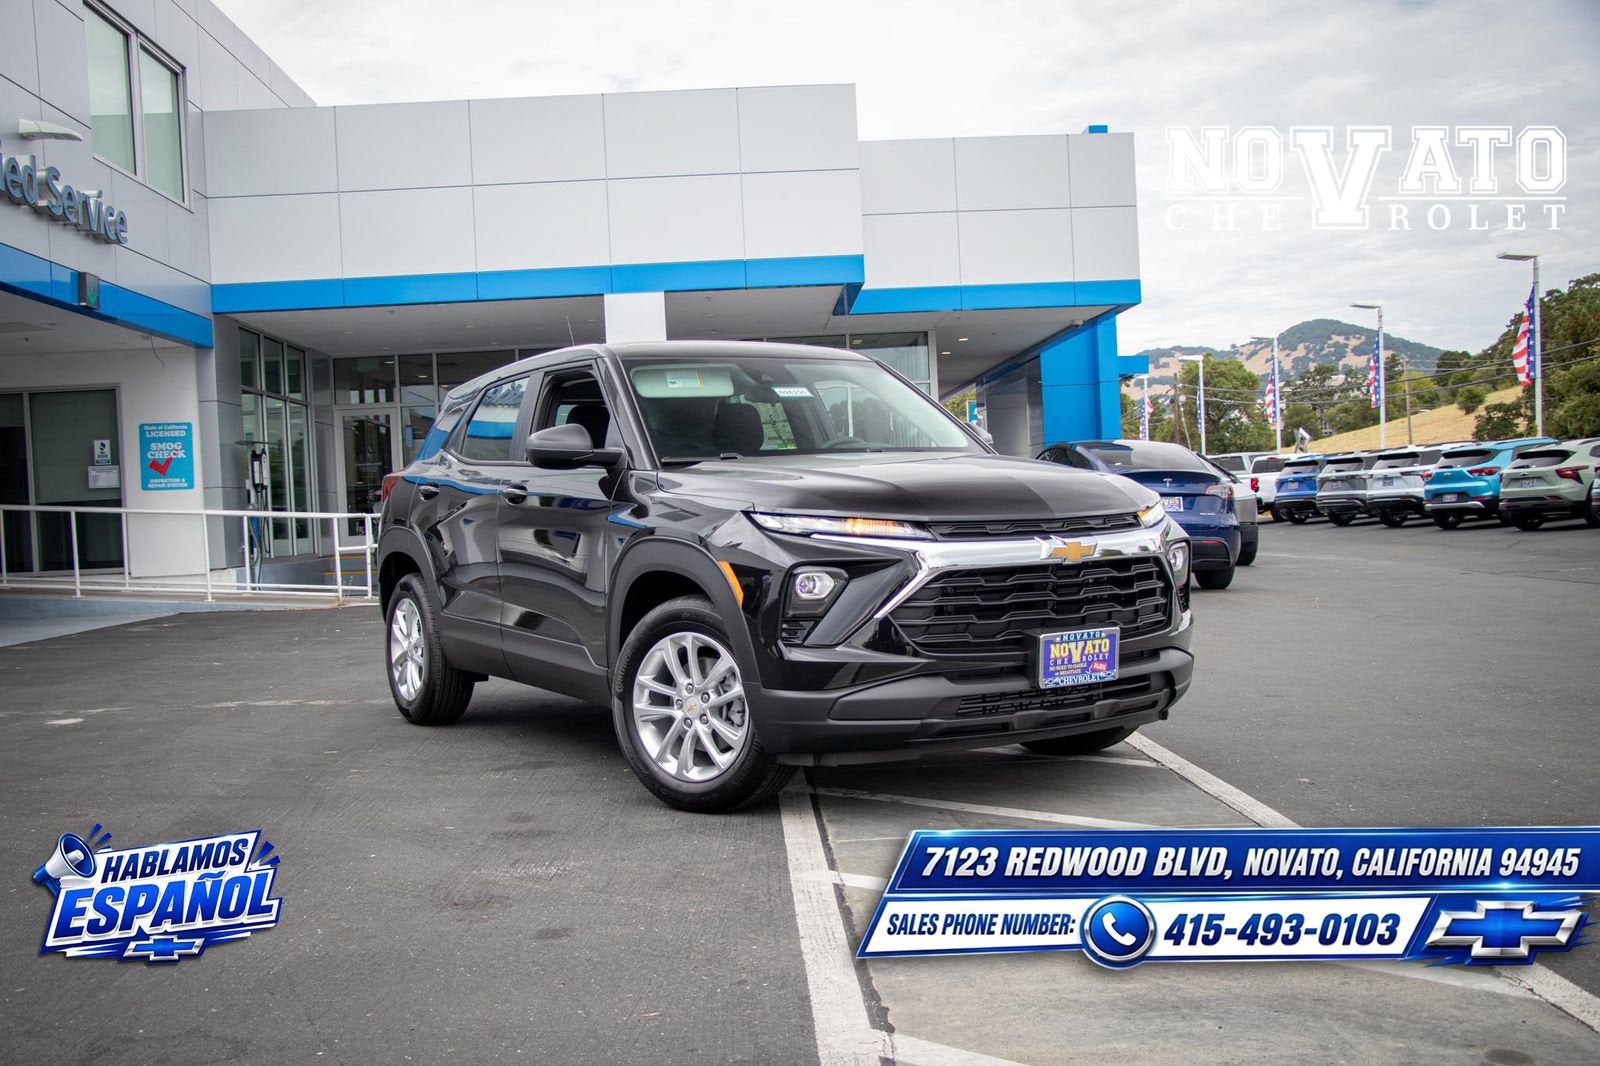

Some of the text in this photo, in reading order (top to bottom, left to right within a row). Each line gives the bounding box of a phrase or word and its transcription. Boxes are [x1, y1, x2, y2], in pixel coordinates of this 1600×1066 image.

[46, 166, 128, 244] Service
[145, 430, 186, 438] LICENSED
[150, 442, 182, 451] SMOG
[147, 450, 187, 459] CHECK
[1062, 632, 1101, 641] NOVATO
[1049, 638, 1110, 663] NOVATO
[1059, 673, 1100, 685] CHEVROLET
